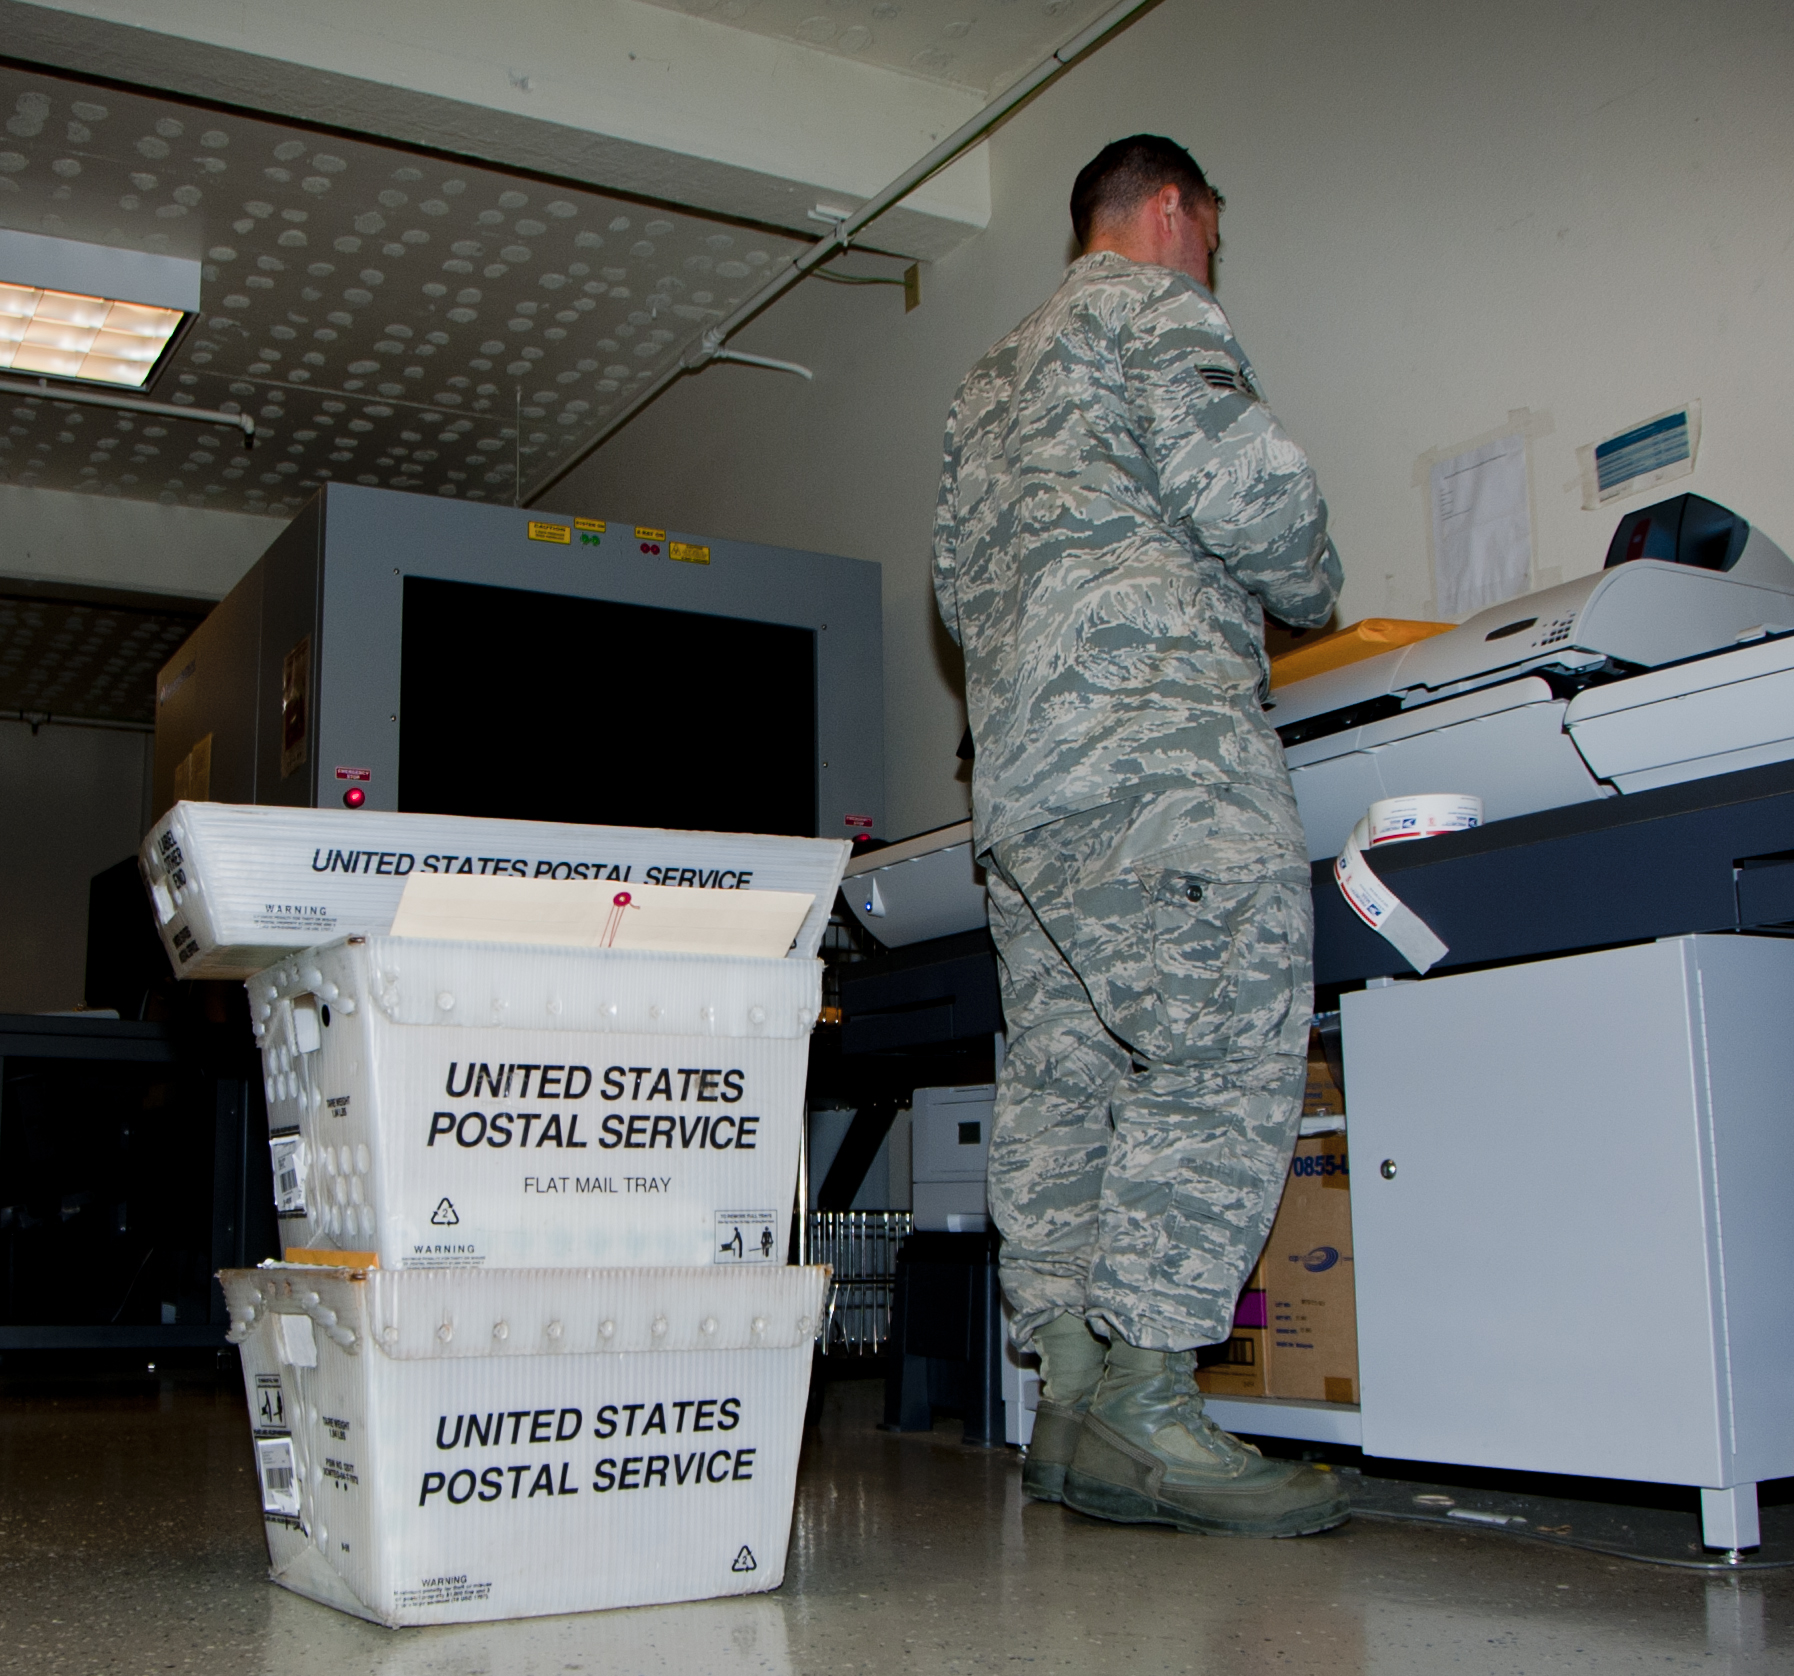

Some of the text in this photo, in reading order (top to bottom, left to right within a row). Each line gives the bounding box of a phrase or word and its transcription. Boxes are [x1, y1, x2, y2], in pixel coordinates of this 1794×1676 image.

[312, 848, 754, 890] UNITED STATES POSTAL SERVICE
[265, 904, 327, 916] WARNING
[445, 1062, 745, 1103] UNITED STATES
[427, 1112, 760, 1150] POSTAL SERVICE
[524, 1177, 671, 1193] FLAT MAIL TRAY
[414, 1244, 475, 1254] WARNING
[436, 1397, 741, 1450] UNITED STATES
[419, 1448, 756, 1507] POSTAL SERVICE
[421, 1575, 467, 1587] WARNING
